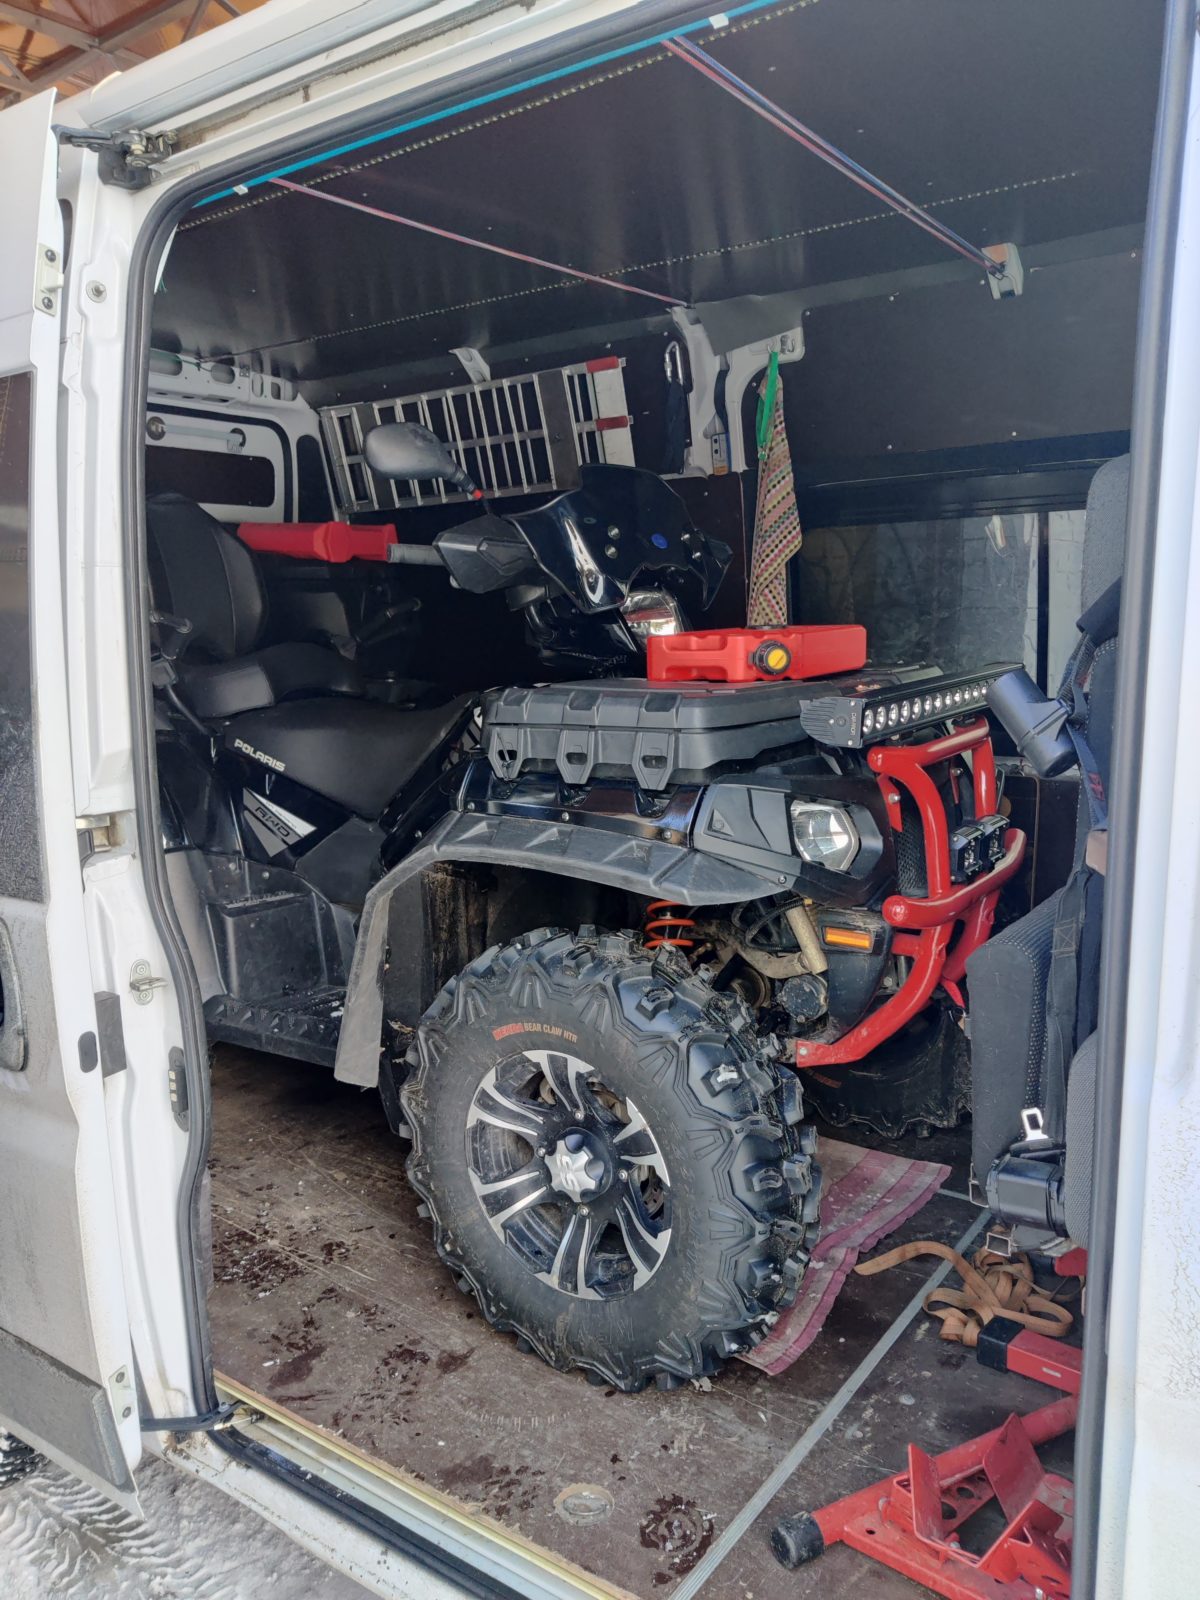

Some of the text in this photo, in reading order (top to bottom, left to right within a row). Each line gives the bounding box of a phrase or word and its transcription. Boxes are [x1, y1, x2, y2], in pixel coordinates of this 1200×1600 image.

[234, 738, 286, 772] POLARIS
[524, 1022, 542, 1032] BEAR
[543, 1024, 562, 1037] CLAW
